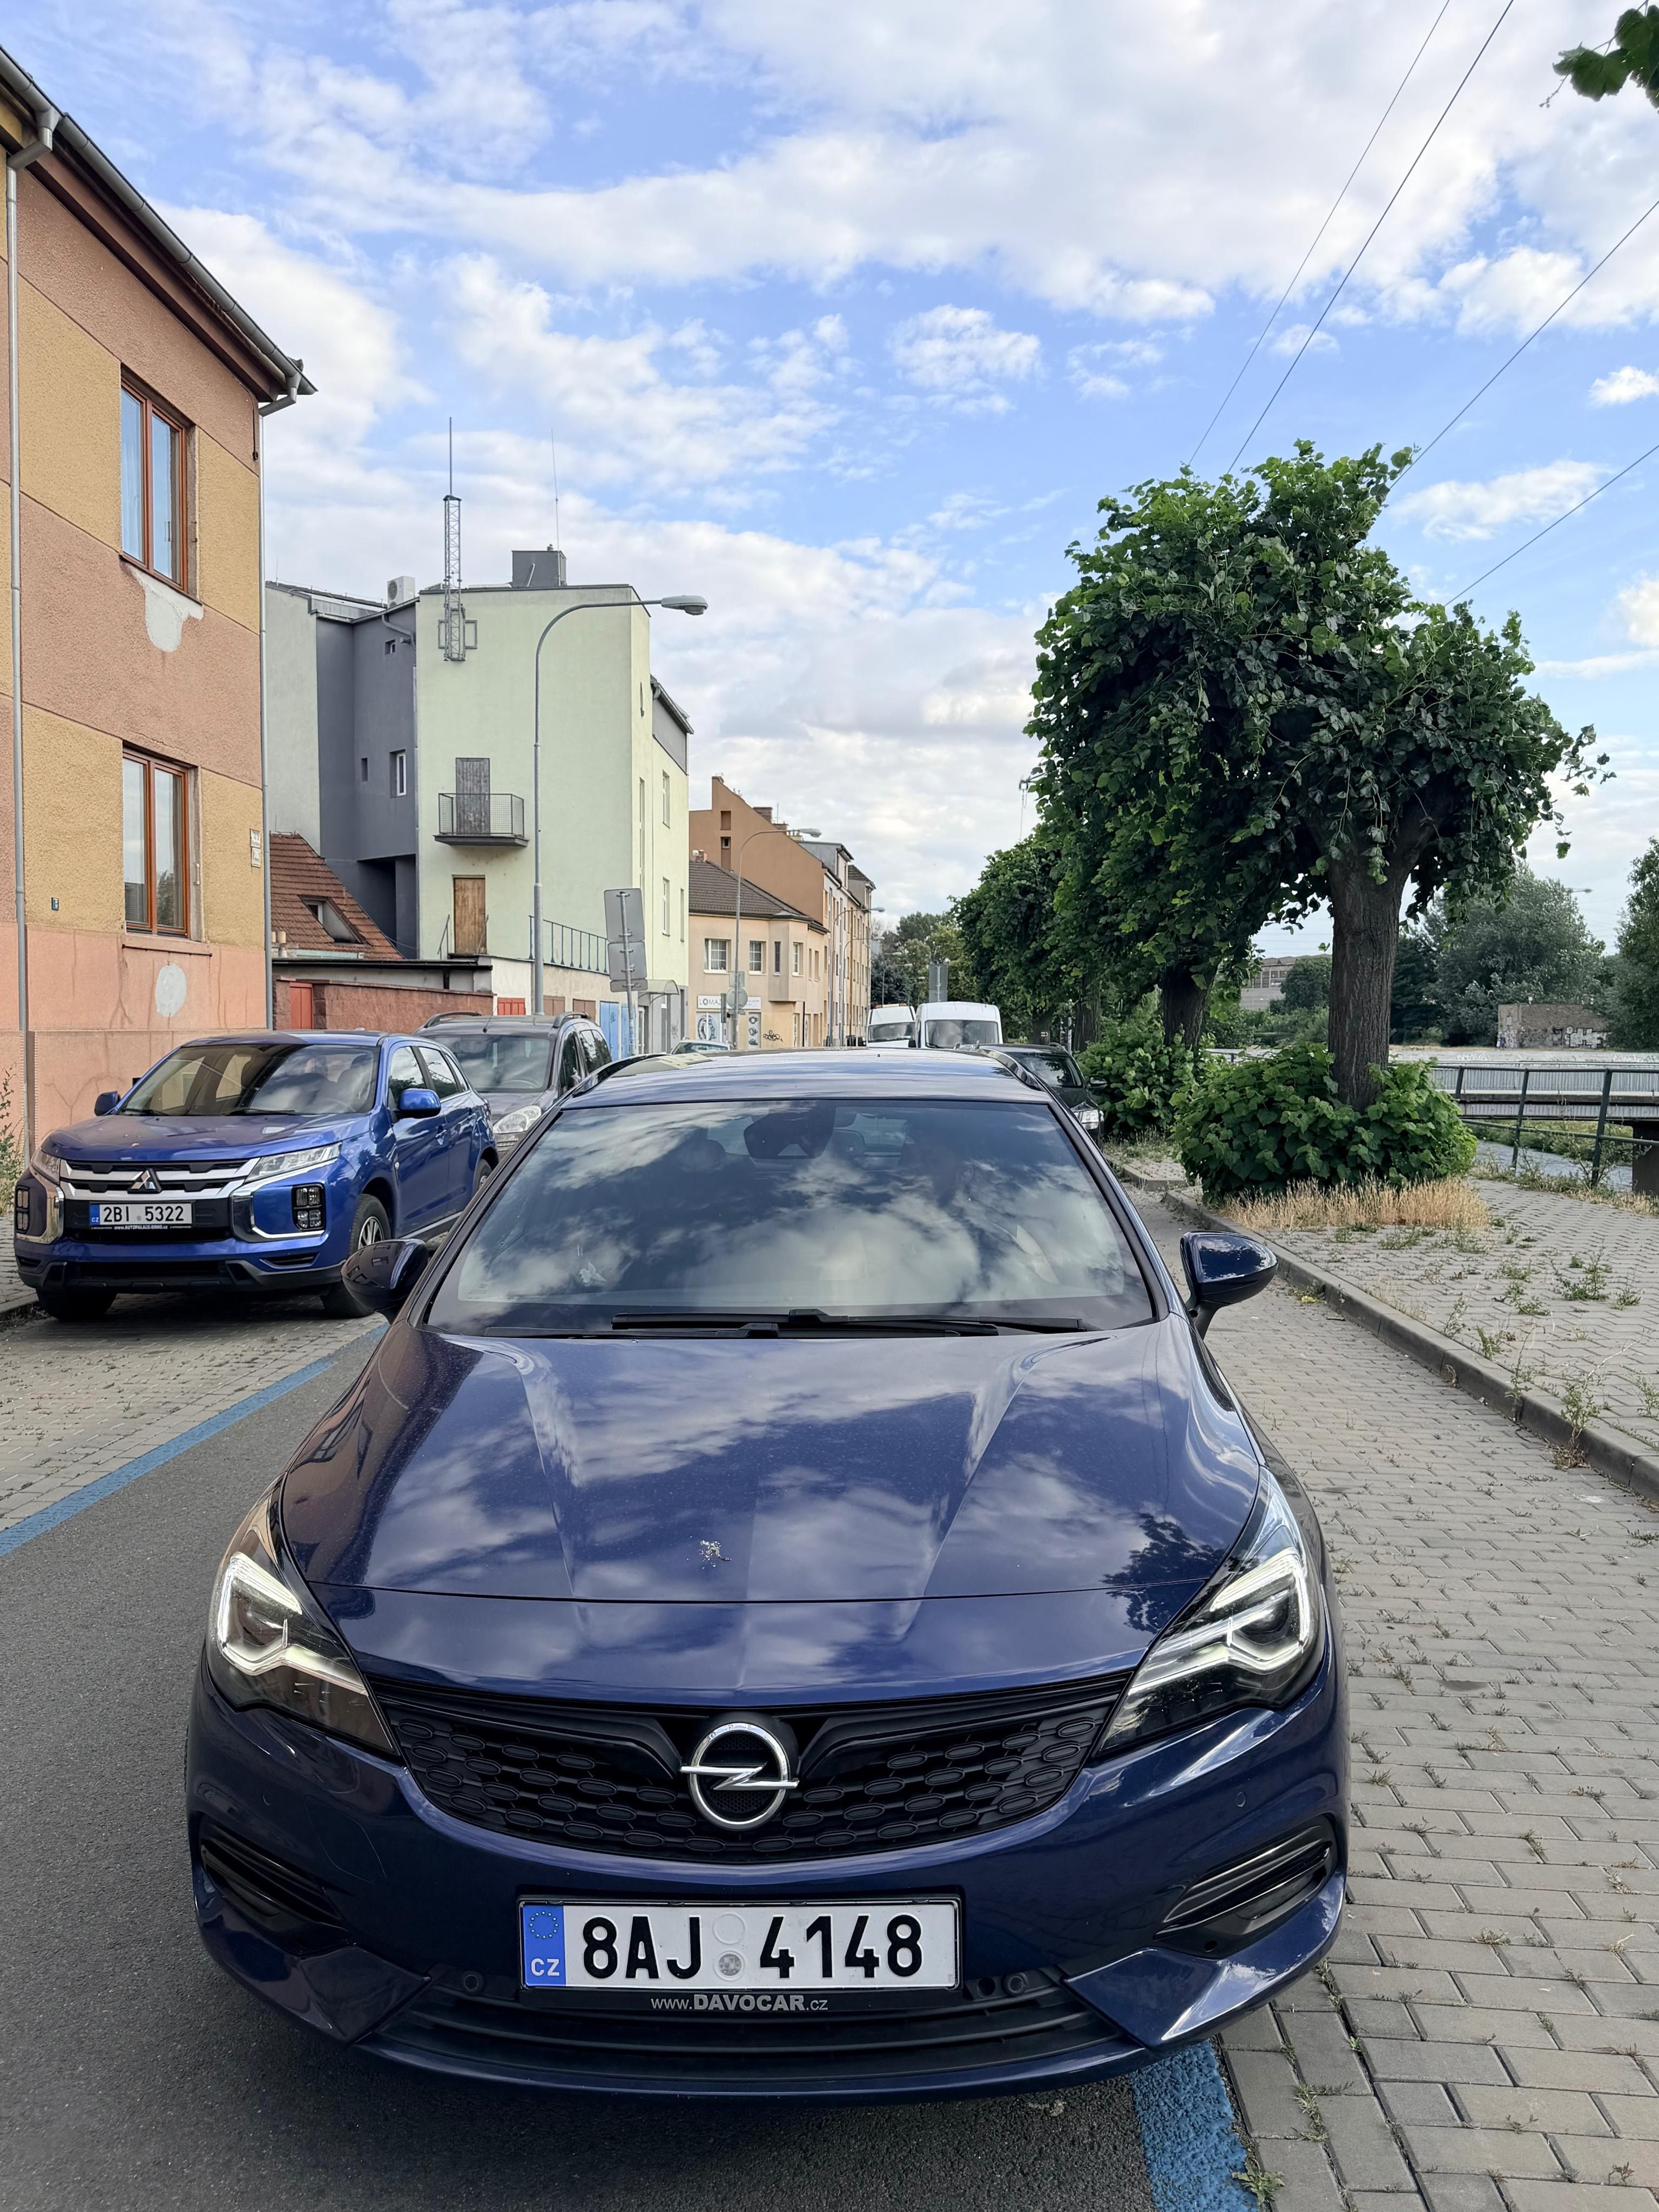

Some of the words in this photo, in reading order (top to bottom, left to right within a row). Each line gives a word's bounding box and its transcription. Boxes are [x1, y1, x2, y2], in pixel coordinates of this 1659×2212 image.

[104, 1206, 129, 1222] 2BI
[145, 1206, 184, 1222] 5322
[583, 1916, 702, 1979] 8AJ
[760, 1914, 922, 1978] 4148
[530, 1958, 559, 1976] CZ
[651, 1994, 828, 2011] www.DAVOCAR.cz
